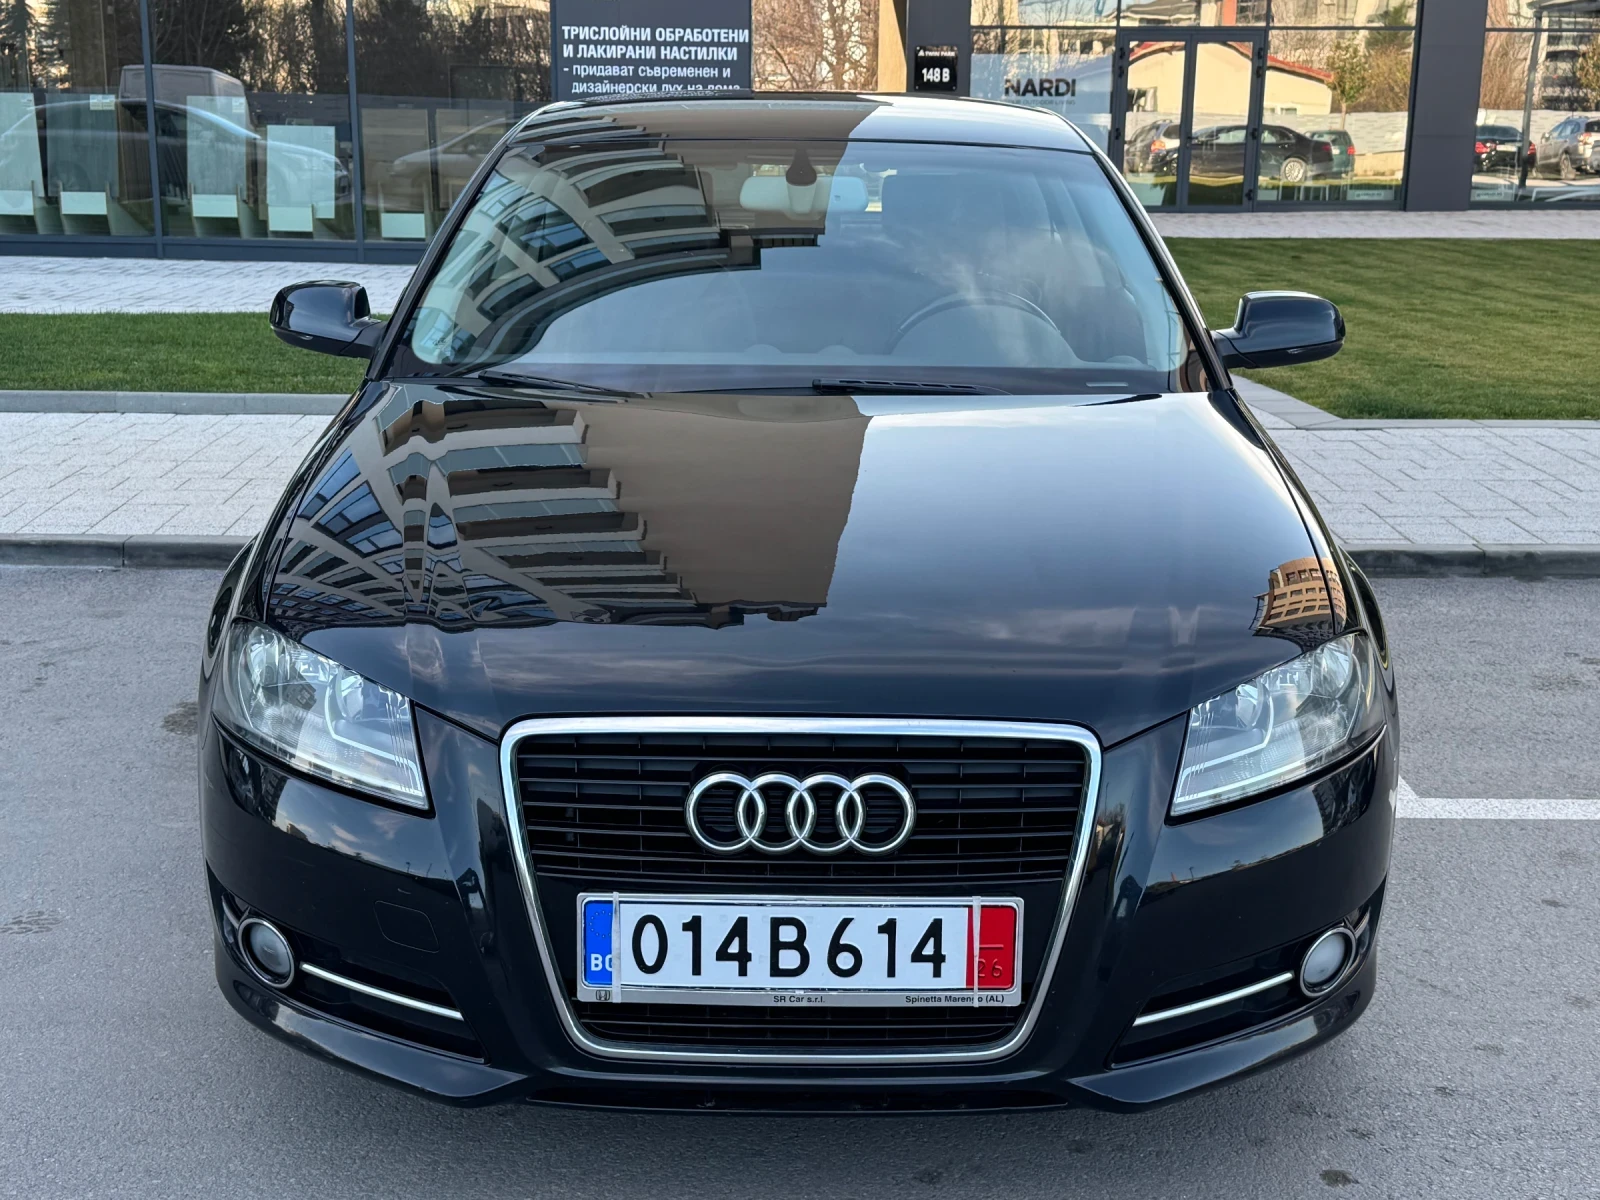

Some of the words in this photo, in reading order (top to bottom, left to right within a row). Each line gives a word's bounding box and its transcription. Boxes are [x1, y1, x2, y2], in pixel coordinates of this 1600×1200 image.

[562, 25, 651, 41] ТРИСЛОЙНИ
[655, 27, 749, 43] ОБРАБОТЕНИ
[563, 44, 574, 58] И
[577, 44, 656, 59] ЛАКИРАНИ
[660, 46, 737, 61] НАСТИЛКИ
[573, 65, 634, 78] придават
[638, 66, 718, 79] съвременен
[722, 67, 731, 78] и
[921, 67, 940, 82] 148
[572, 80, 657, 93] дизайнерски
[1004, 78, 1076, 97] NARDI
[631, 913, 947, 978] 014B614
[773, 995, 786, 1003] SR
[788, 995, 804, 1003] Car
[806, 995, 826, 1003] s.r.l.
[905, 995, 942, 1004] Spinetta
[985, 994, 1005, 1004] (AL)
